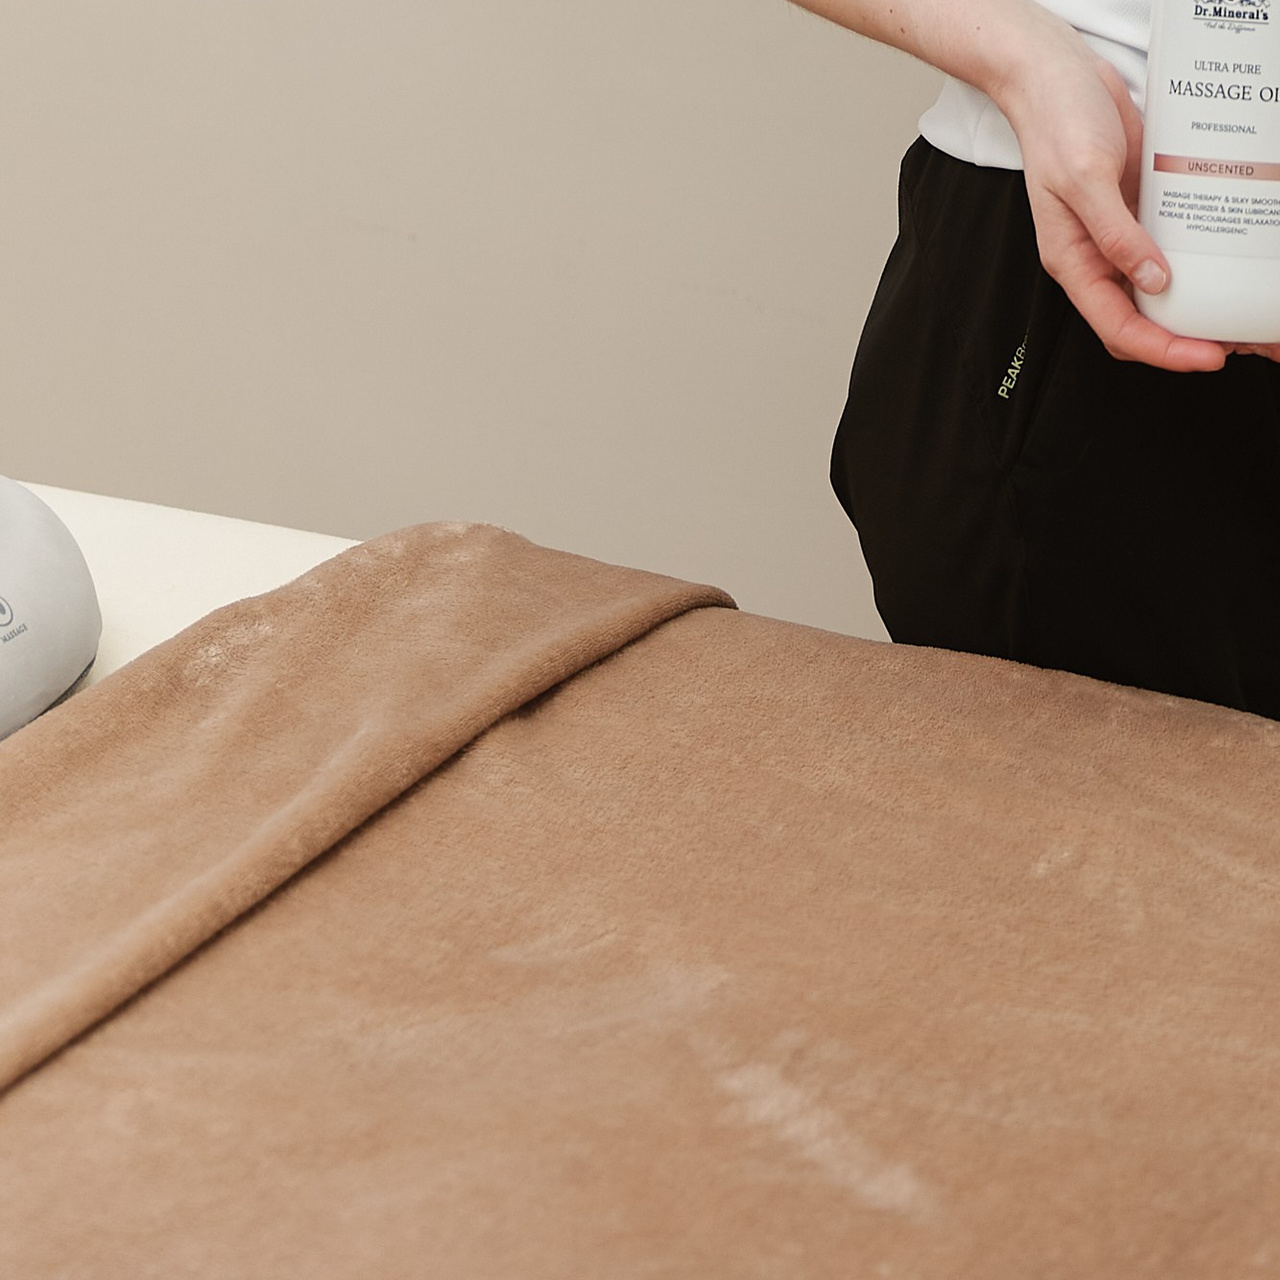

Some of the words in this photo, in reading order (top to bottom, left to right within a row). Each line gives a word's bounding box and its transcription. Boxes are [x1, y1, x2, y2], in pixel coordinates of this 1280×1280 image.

[1194, 5, 1269, 21] Dr.Mineral's
[1194, 60, 1229, 73] ULTRA
[1232, 63, 1261, 75] PURE
[1169, 79, 1252, 101] MASSAGE
[1191, 121, 1257, 134] PROFESSIONAL
[1188, 161, 1254, 176] UNSCENTED
[1163, 190, 1191, 200] MASSAGE
[1193, 192, 1221, 202] THERAPY
[1231, 196, 1248, 204] SILKY
[1251, 197, 1280, 205] SMOOTH
[1161, 200, 1176, 208] BODY
[1228, 206, 1243, 214] SKIN
[1193, 213, 1241, 224] ENCOURAGES
[1186, 224, 1248, 235] HYPOALLERGENIC
